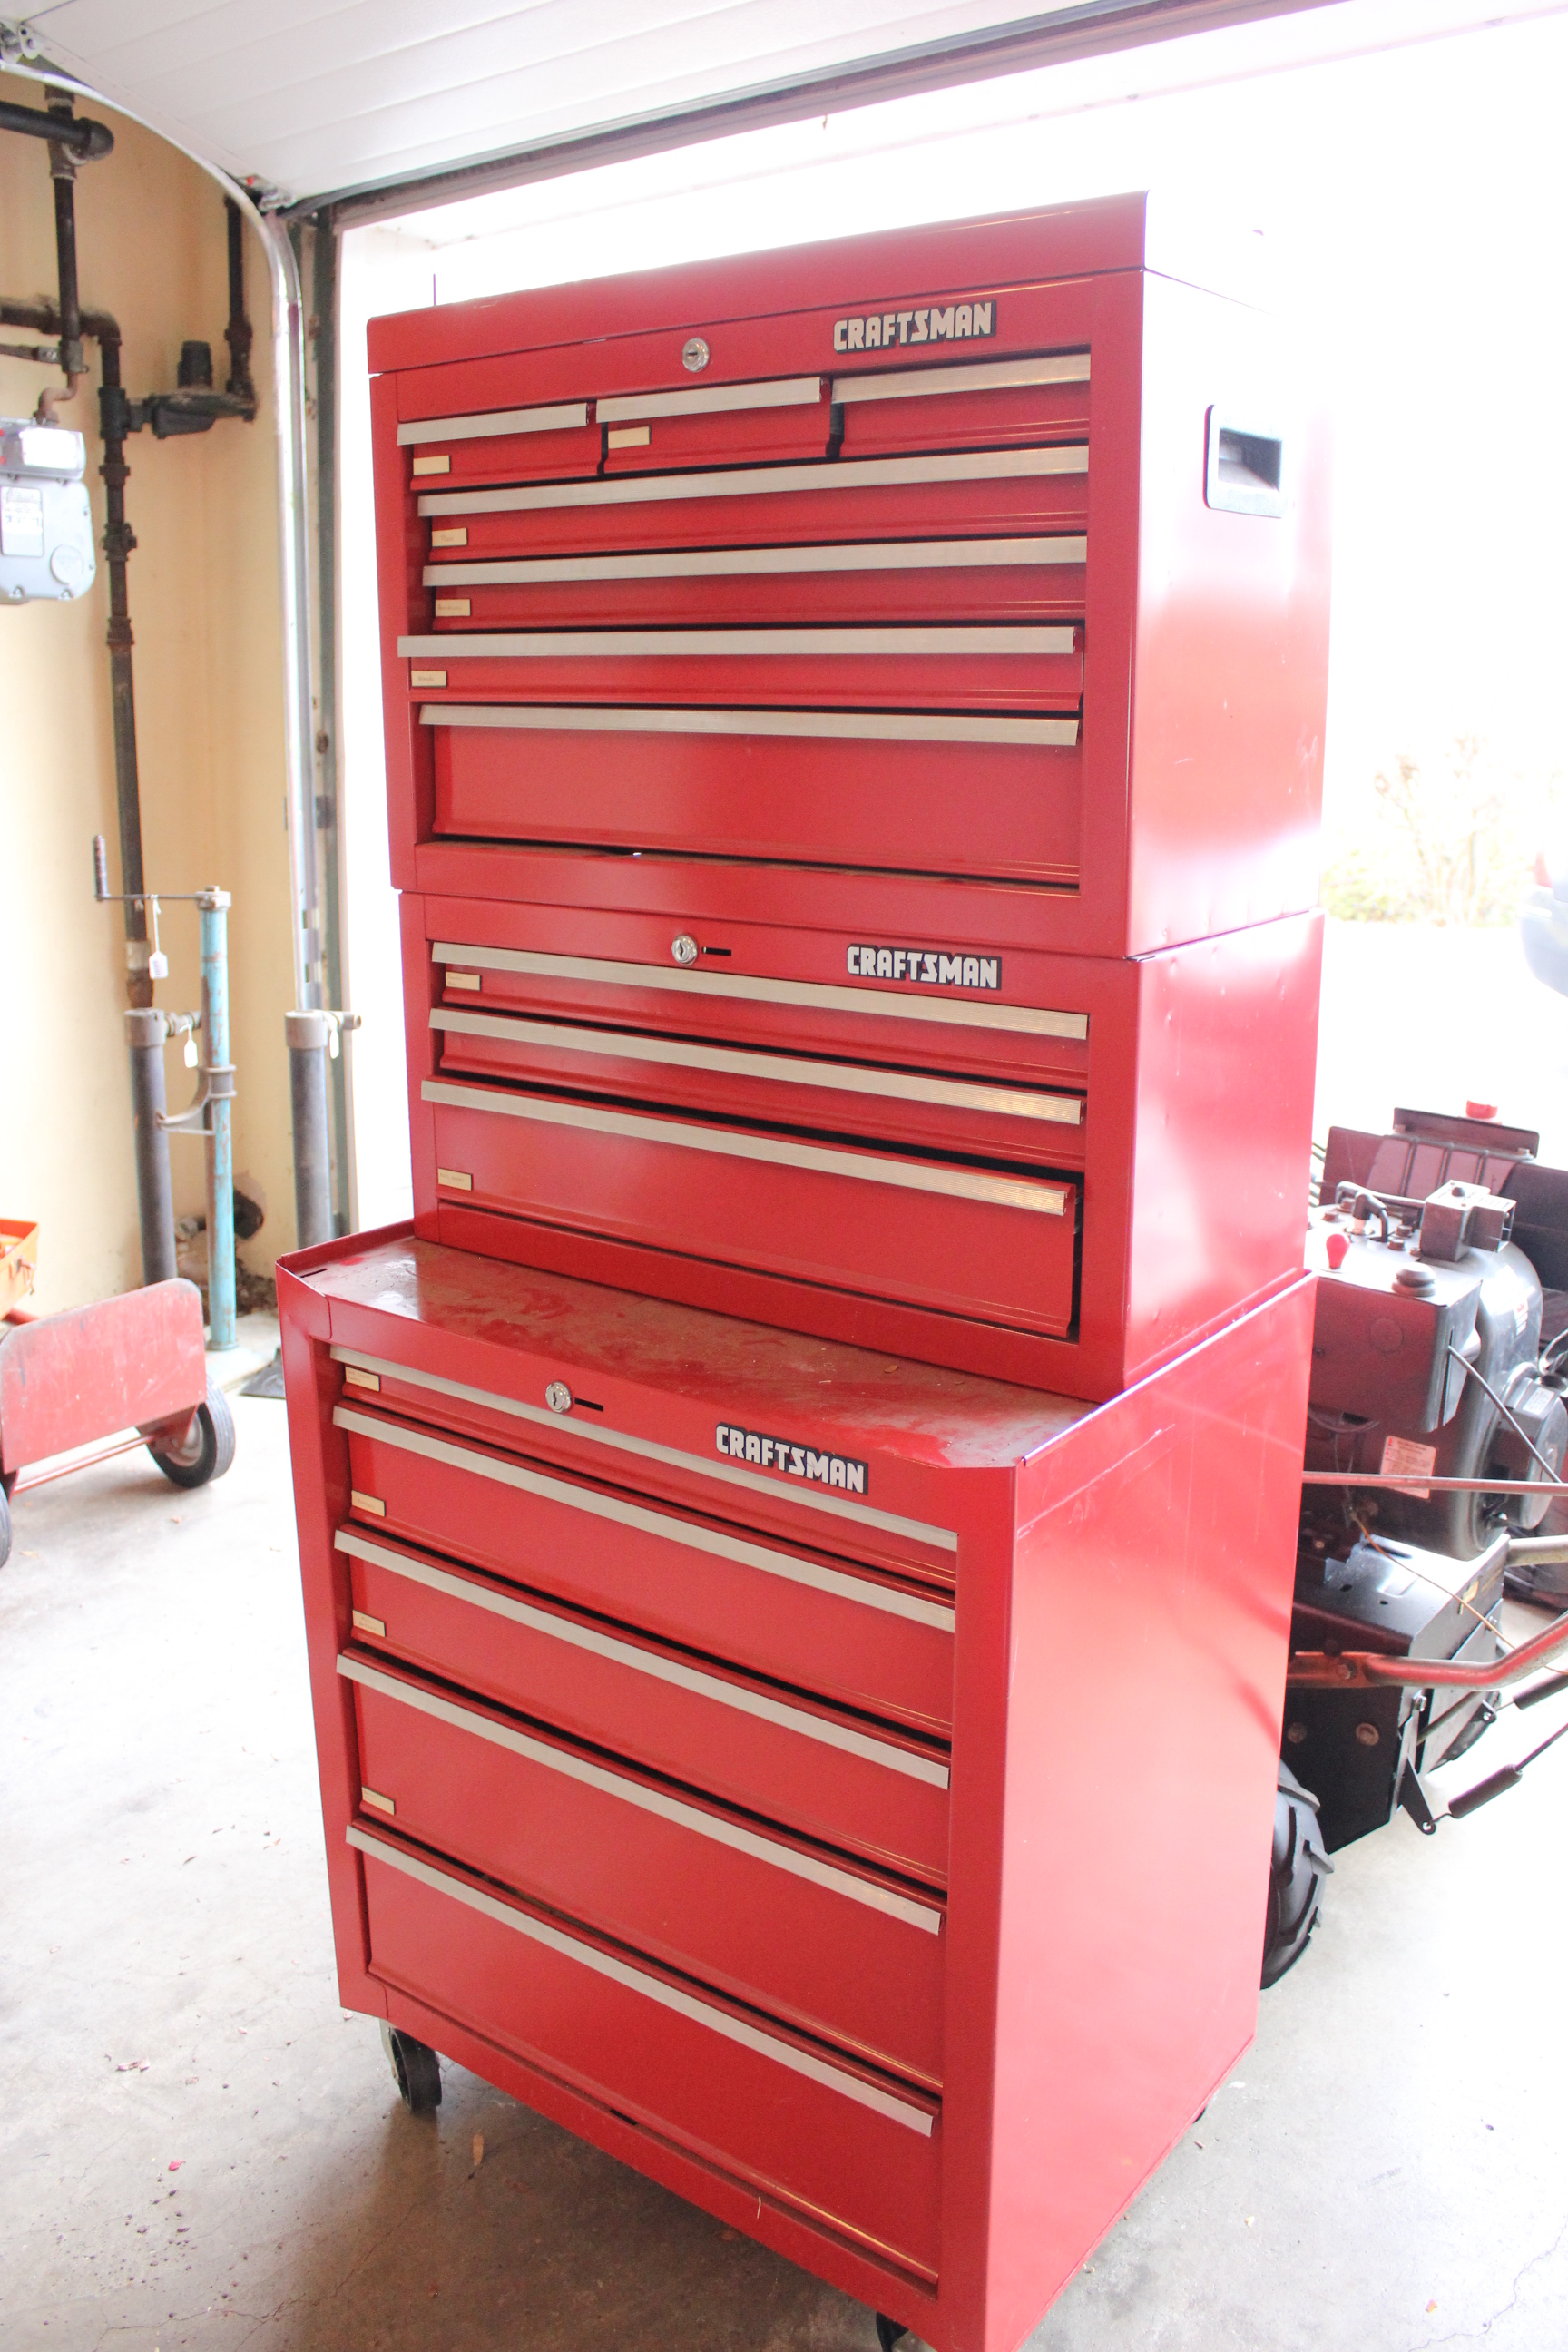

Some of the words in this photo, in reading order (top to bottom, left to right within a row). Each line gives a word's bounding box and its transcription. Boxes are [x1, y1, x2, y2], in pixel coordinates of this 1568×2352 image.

[833, 301, 995, 352] CRAFTSMAN
[847, 946, 999, 989] CRAFTSMAN
[715, 1425, 866, 1494] CRAFTSMAN
